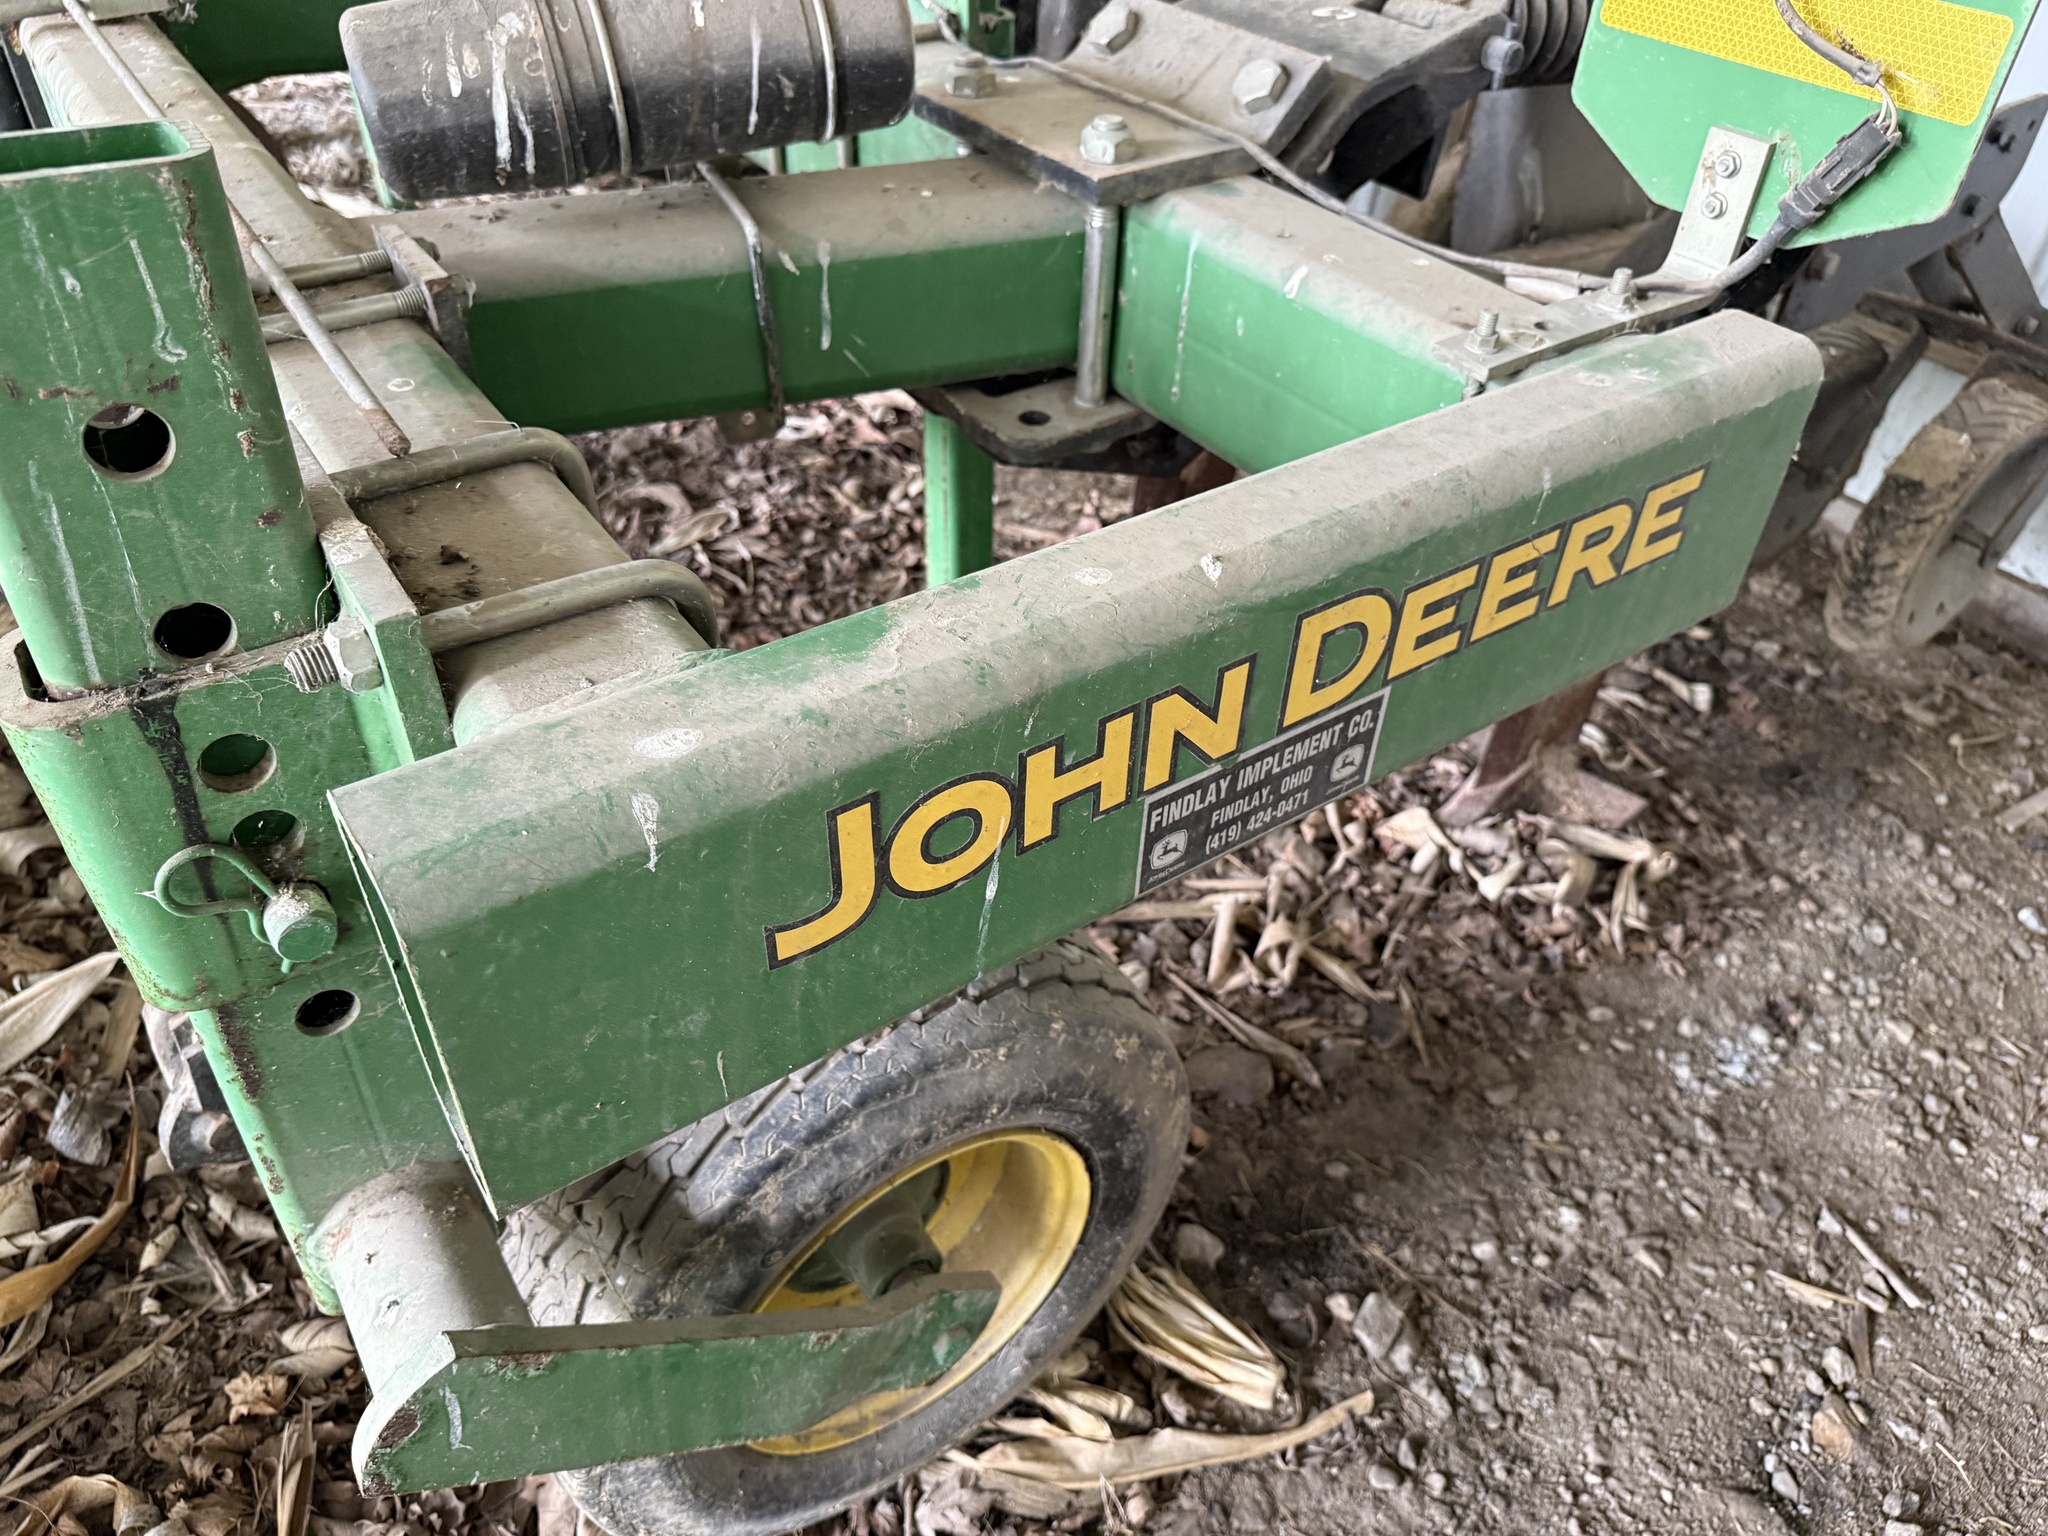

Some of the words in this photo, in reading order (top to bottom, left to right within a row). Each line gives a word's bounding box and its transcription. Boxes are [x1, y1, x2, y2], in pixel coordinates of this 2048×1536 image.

[770, 657, 1255, 967] JOHN
[1280, 468, 1704, 730] DEERE
[1150, 775, 1231, 833] FINDLAY
[1237, 722, 1344, 791] IMPLEMENT
[1347, 709, 1375, 739] CO.
[1210, 785, 1274, 829] FINDLAY,
[1280, 764, 1314, 795] OHIO
[1205, 820, 1243, 855] (419)
[1246, 789, 1309, 831] 424-0471
